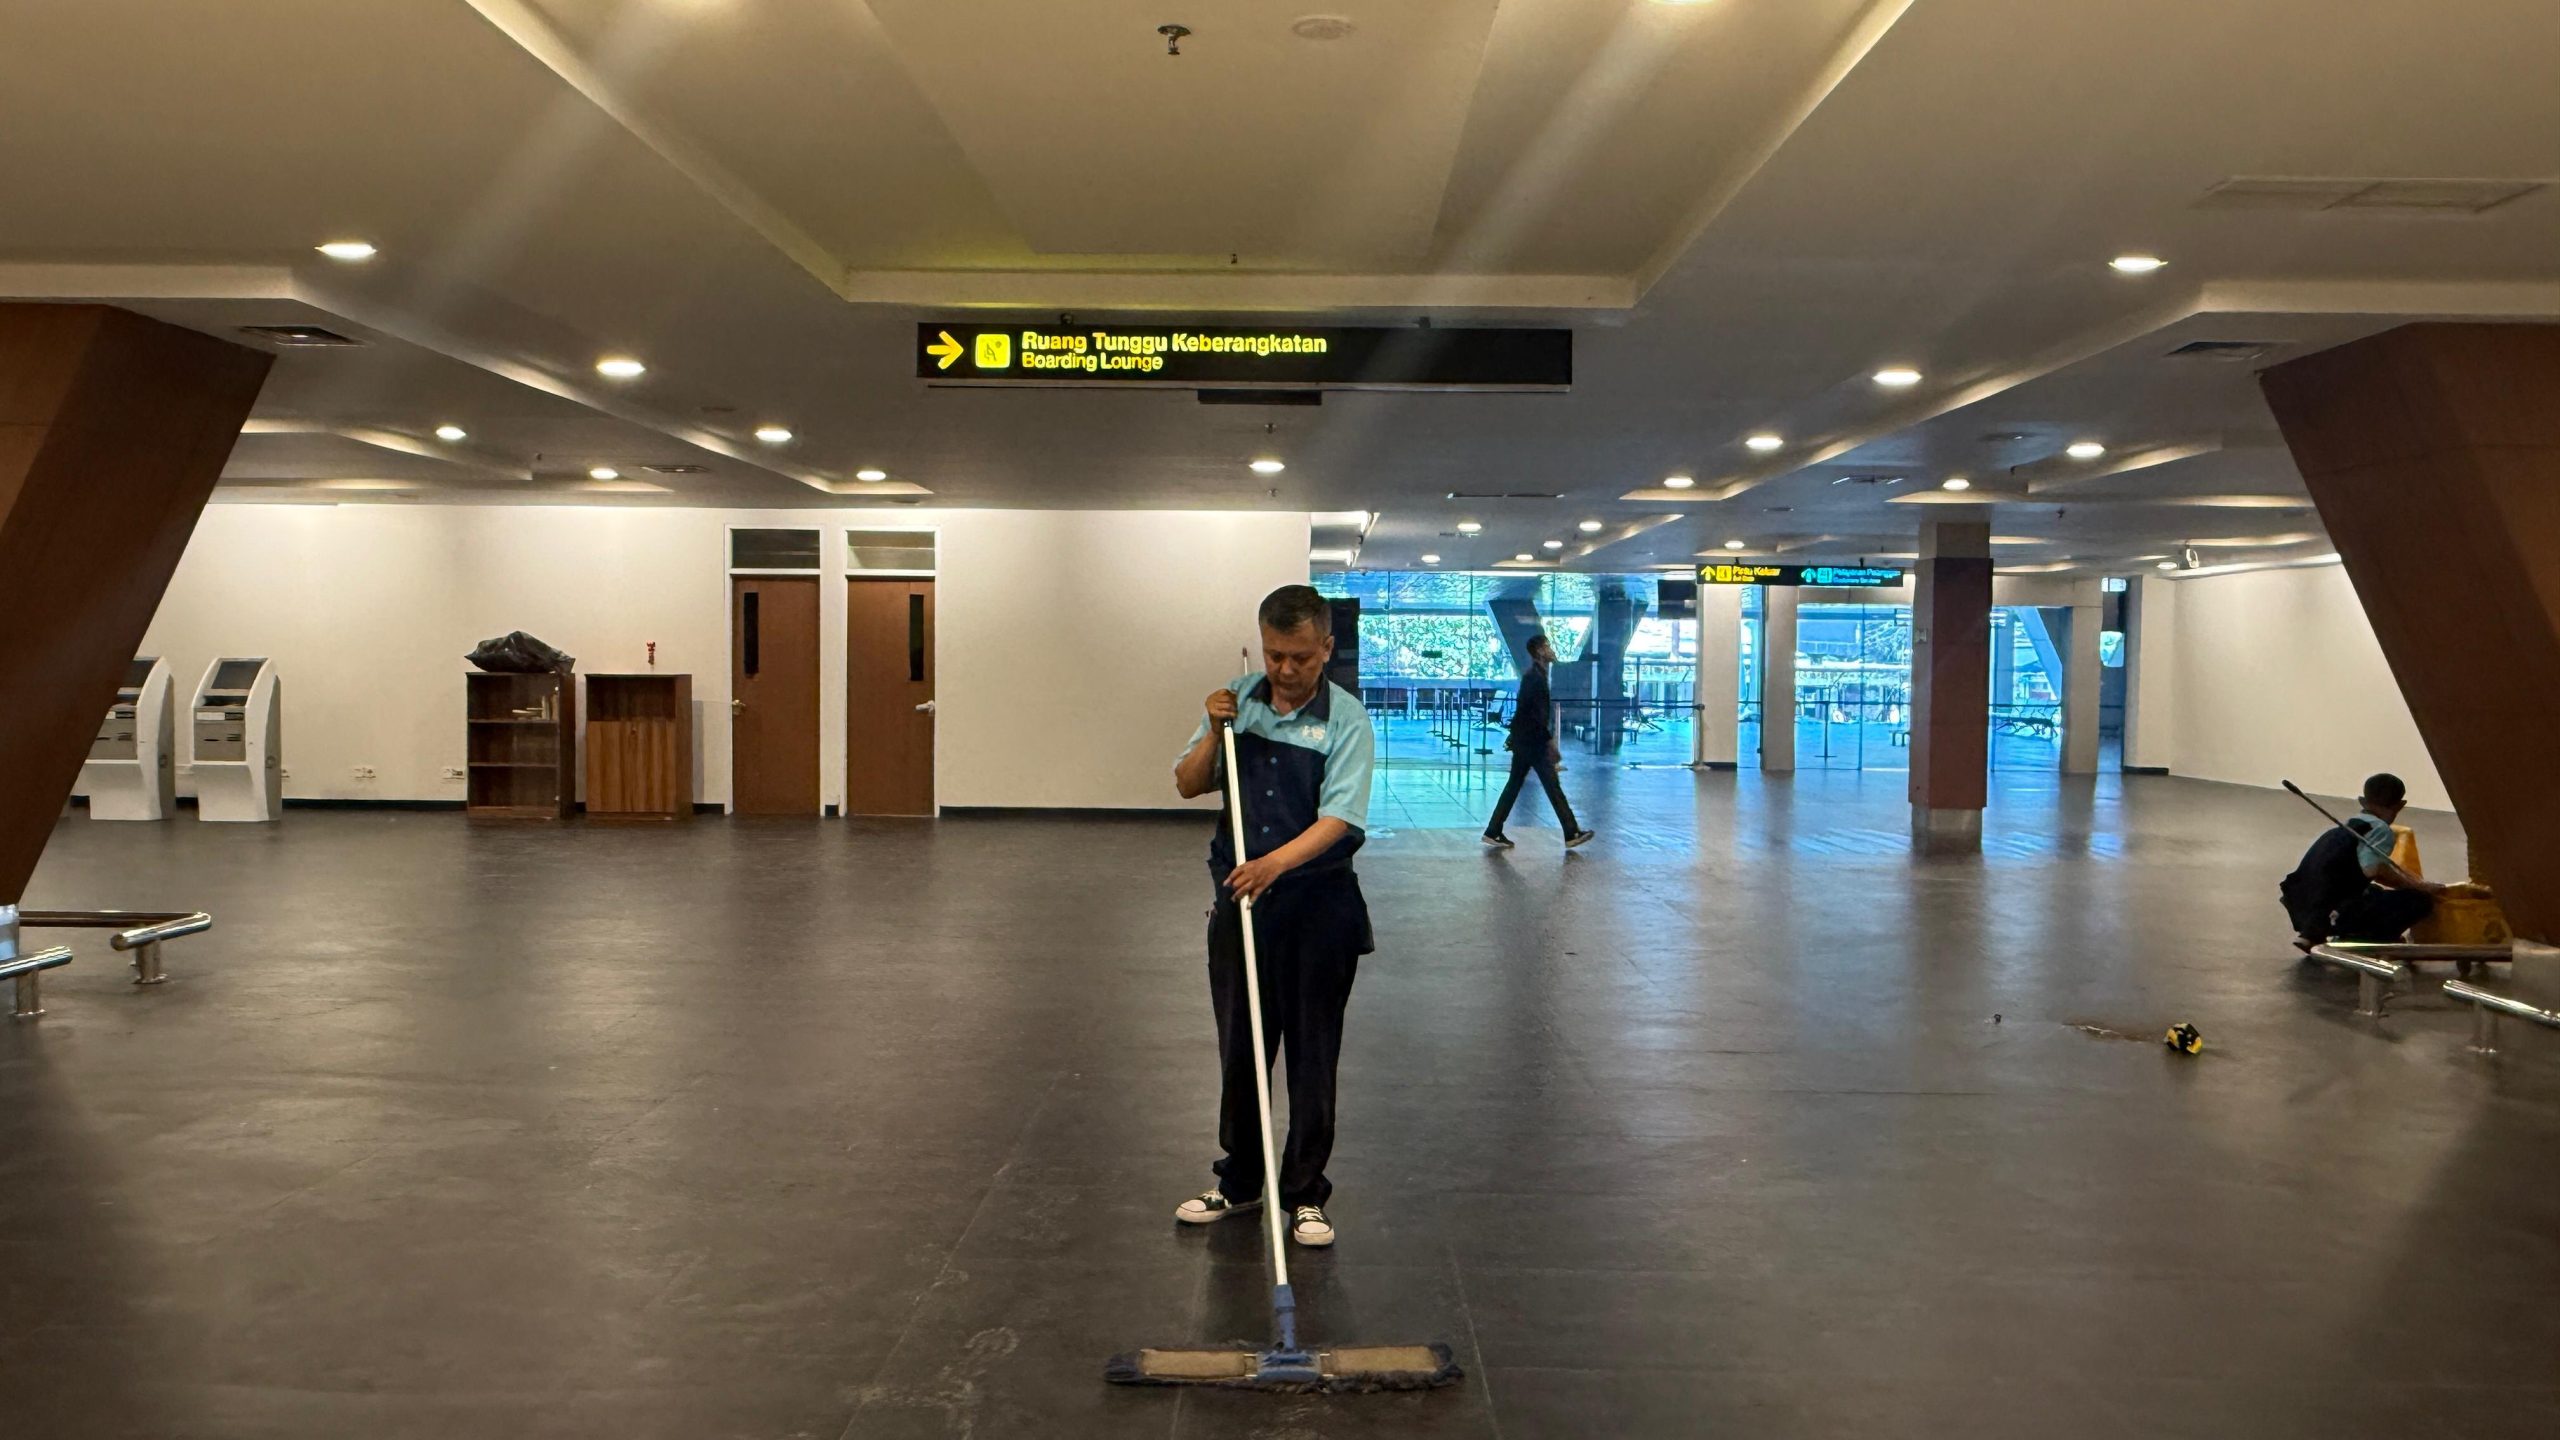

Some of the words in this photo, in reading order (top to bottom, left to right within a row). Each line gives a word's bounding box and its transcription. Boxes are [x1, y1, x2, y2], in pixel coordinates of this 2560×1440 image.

[1022, 331, 1087, 354] Ruang
[1092, 332, 1168, 355] Tunggu
[1171, 333, 1327, 356] Keberangkatan
[1022, 352, 1097, 372] Boarding
[1100, 352, 1163, 372] Lounge
